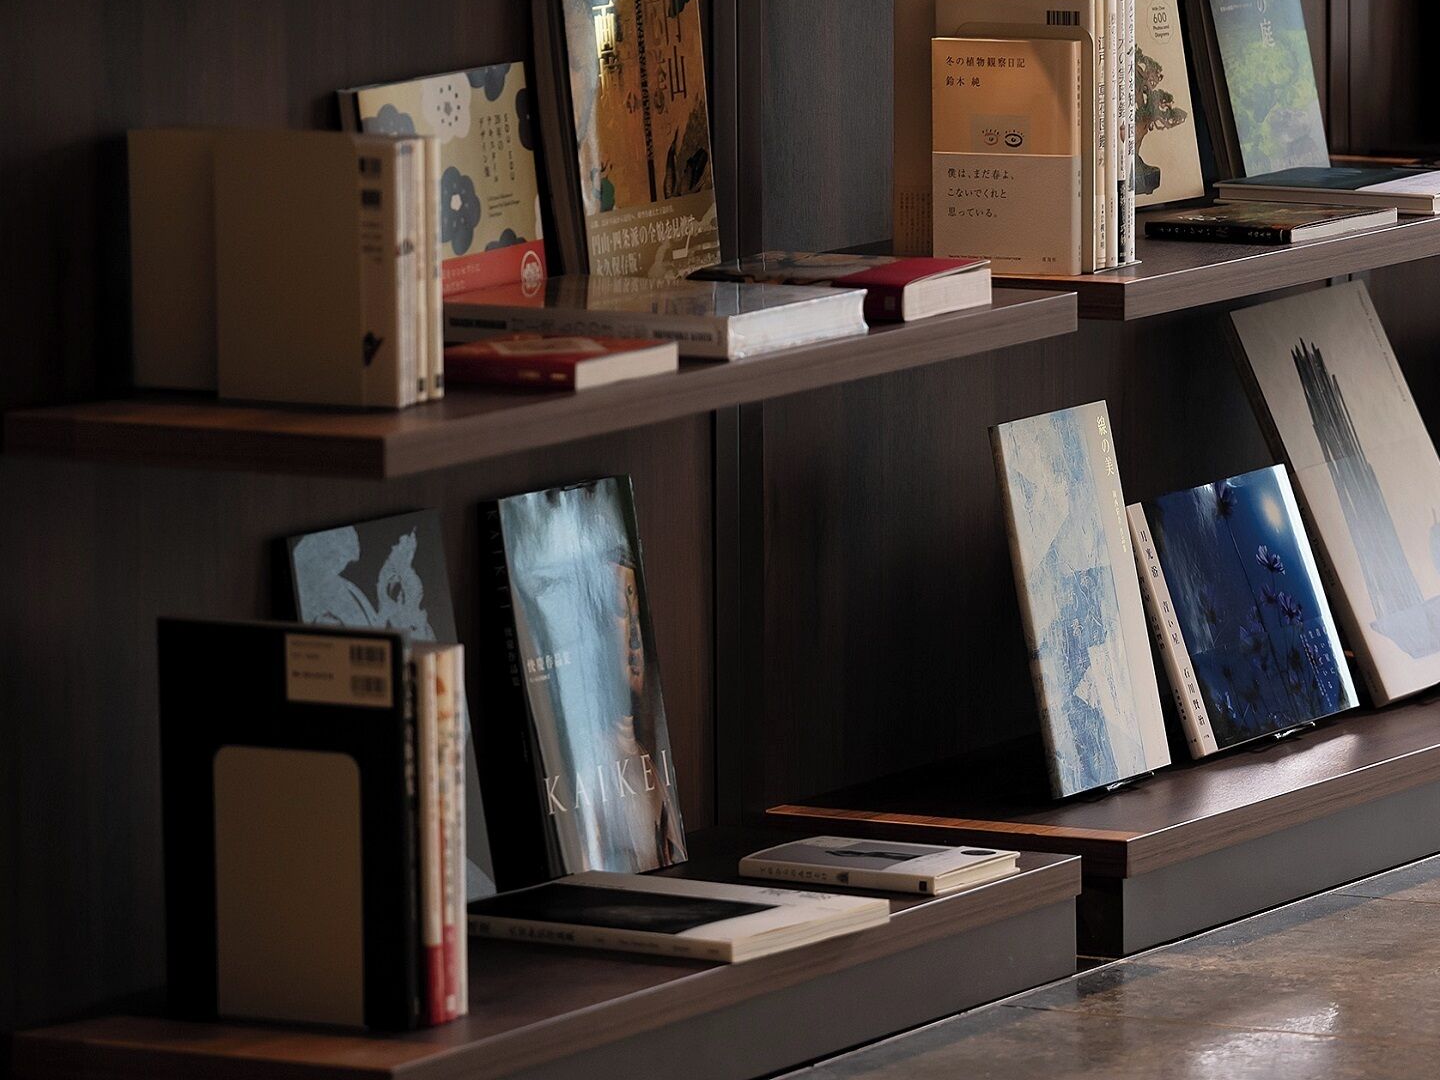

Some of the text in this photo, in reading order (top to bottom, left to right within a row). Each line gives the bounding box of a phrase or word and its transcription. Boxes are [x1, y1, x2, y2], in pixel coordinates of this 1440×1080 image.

[1153, 11, 1167, 24] 600
[946, 55, 1026, 69] 冬の植物観察日記
[945, 75, 966, 87] 鈴木
[947, 188, 1007, 199] こないでくれと
[947, 206, 998, 218] 思っている。
[544, 749, 671, 816] KAIKEI
